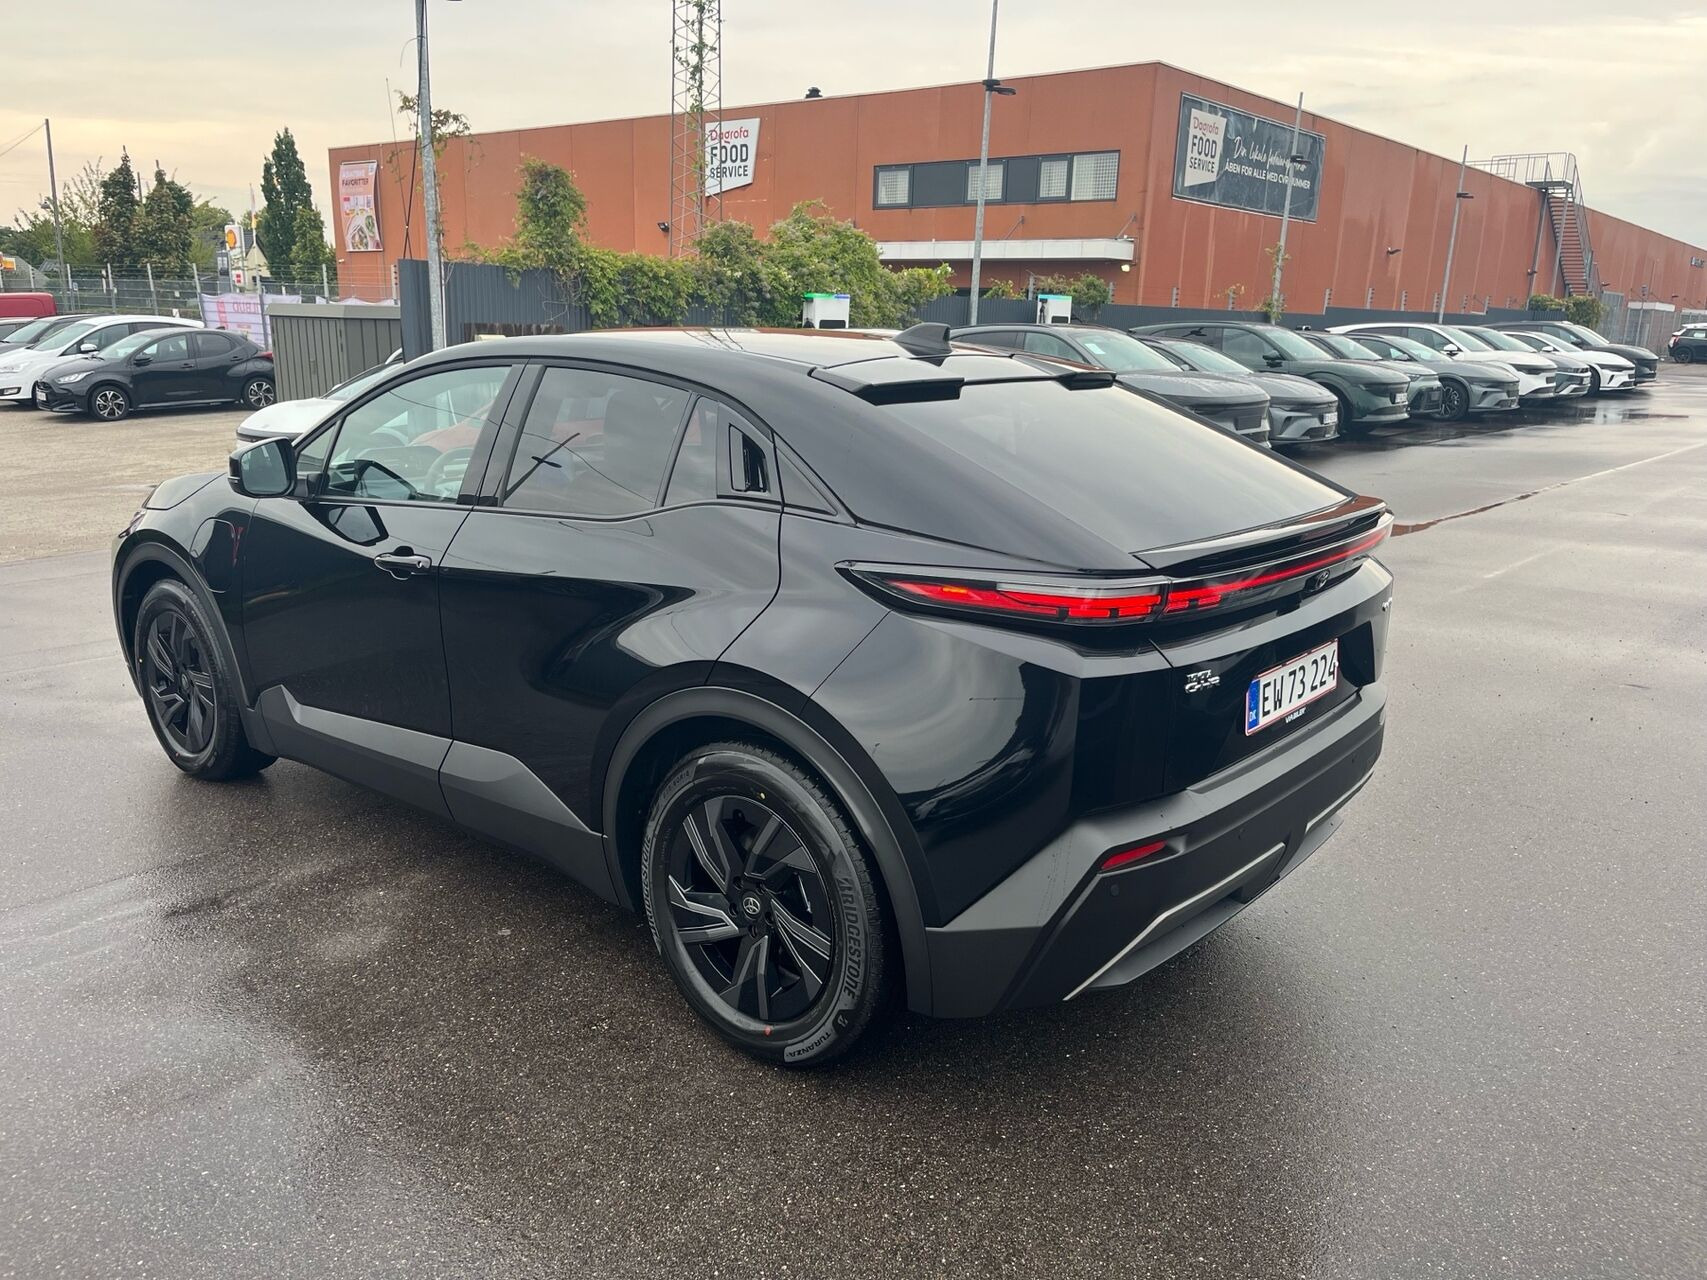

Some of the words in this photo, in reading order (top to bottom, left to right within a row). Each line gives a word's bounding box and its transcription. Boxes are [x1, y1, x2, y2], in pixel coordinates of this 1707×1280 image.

[709, 126, 749, 144] Dagrofa
[1193, 116, 1219, 136] Dagrofa
[711, 143, 749, 165] FOOD
[1191, 134, 1217, 159] FOOD
[710, 165, 749, 179] SERVICE
[1189, 156, 1215, 173] SERVICE
[1262, 675, 1284, 717] EW
[1288, 664, 1306, 704] 73
[1310, 649, 1337, 693] 224
